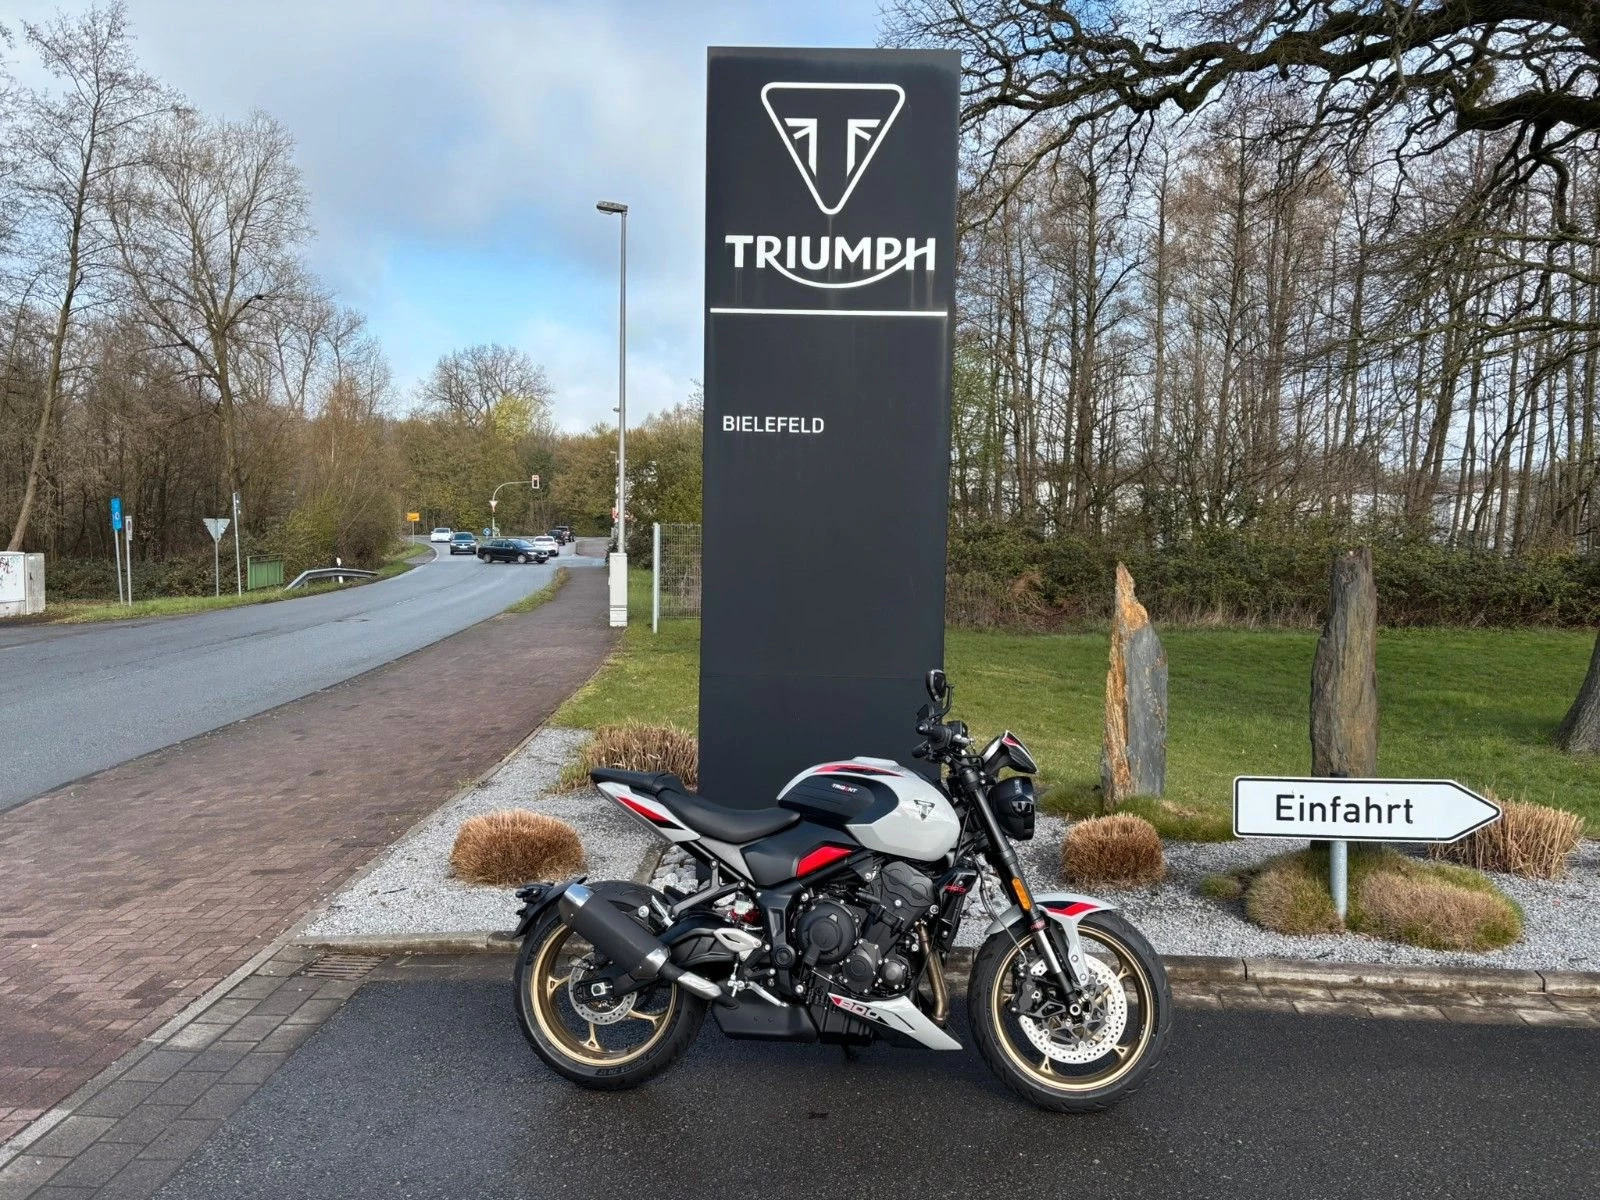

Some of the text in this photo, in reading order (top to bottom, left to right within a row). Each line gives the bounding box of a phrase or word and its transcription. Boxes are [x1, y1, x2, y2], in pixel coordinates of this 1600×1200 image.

[725, 235, 936, 288] TRIUMPH
[722, 415, 825, 434] BIELEFELD
[1275, 794, 1414, 824] Einfahrt
